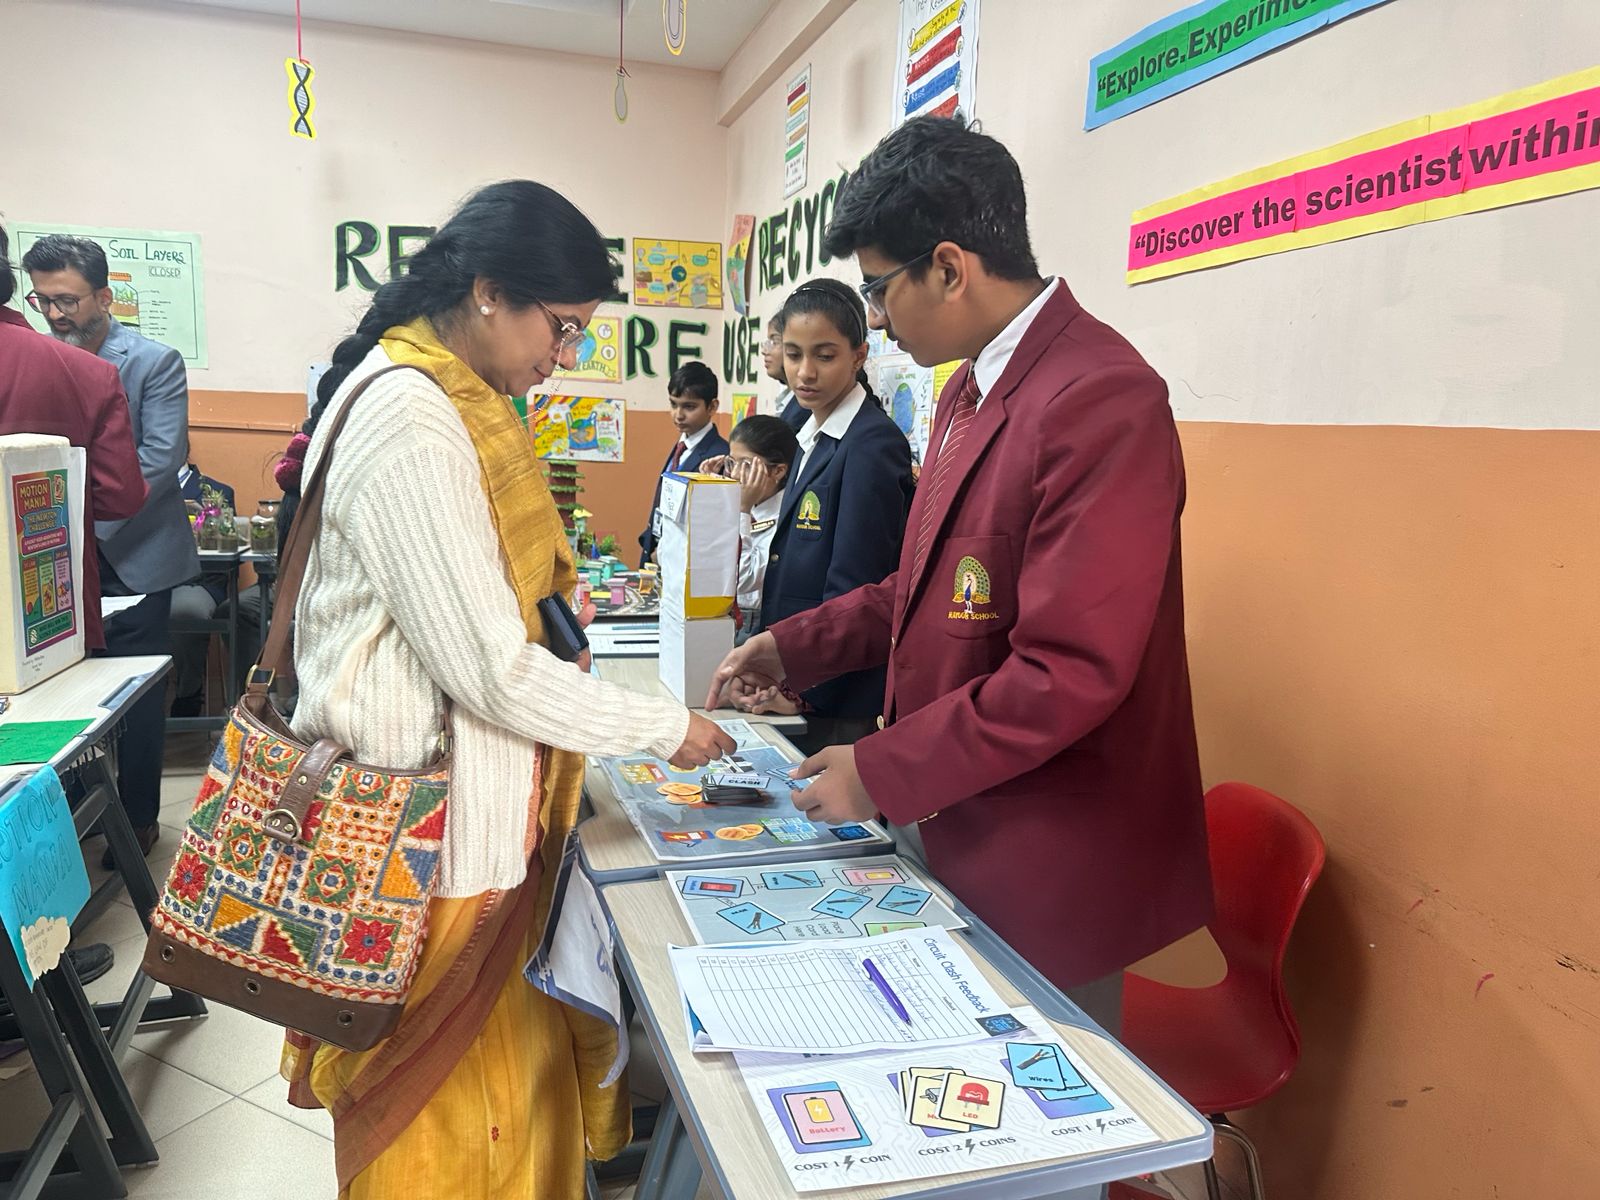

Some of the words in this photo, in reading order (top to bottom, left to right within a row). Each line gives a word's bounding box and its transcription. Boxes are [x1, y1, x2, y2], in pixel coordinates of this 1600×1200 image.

[1251, 192, 1295, 227] the
[1306, 145, 1463, 216] scientist
[20, 483, 48, 498] MOTION
[24, 496, 46, 510] MANIA
[924, 937, 947, 961] Circuit
[940, 960, 961, 982] Clash
[955, 979, 990, 1014] Feedback
[1028, 1075, 1054, 1084] Wires
[962, 1112, 979, 1120] LED
[809, 1125, 846, 1135] Battery
[1051, 1126, 1082, 1136] COST
[1108, 1117, 1136, 1127] COIN
[918, 1147, 949, 1156] COST
[979, 1137, 1017, 1148] COINS
[794, 1161, 828, 1172] COST
[860, 1154, 892, 1164] COIN
